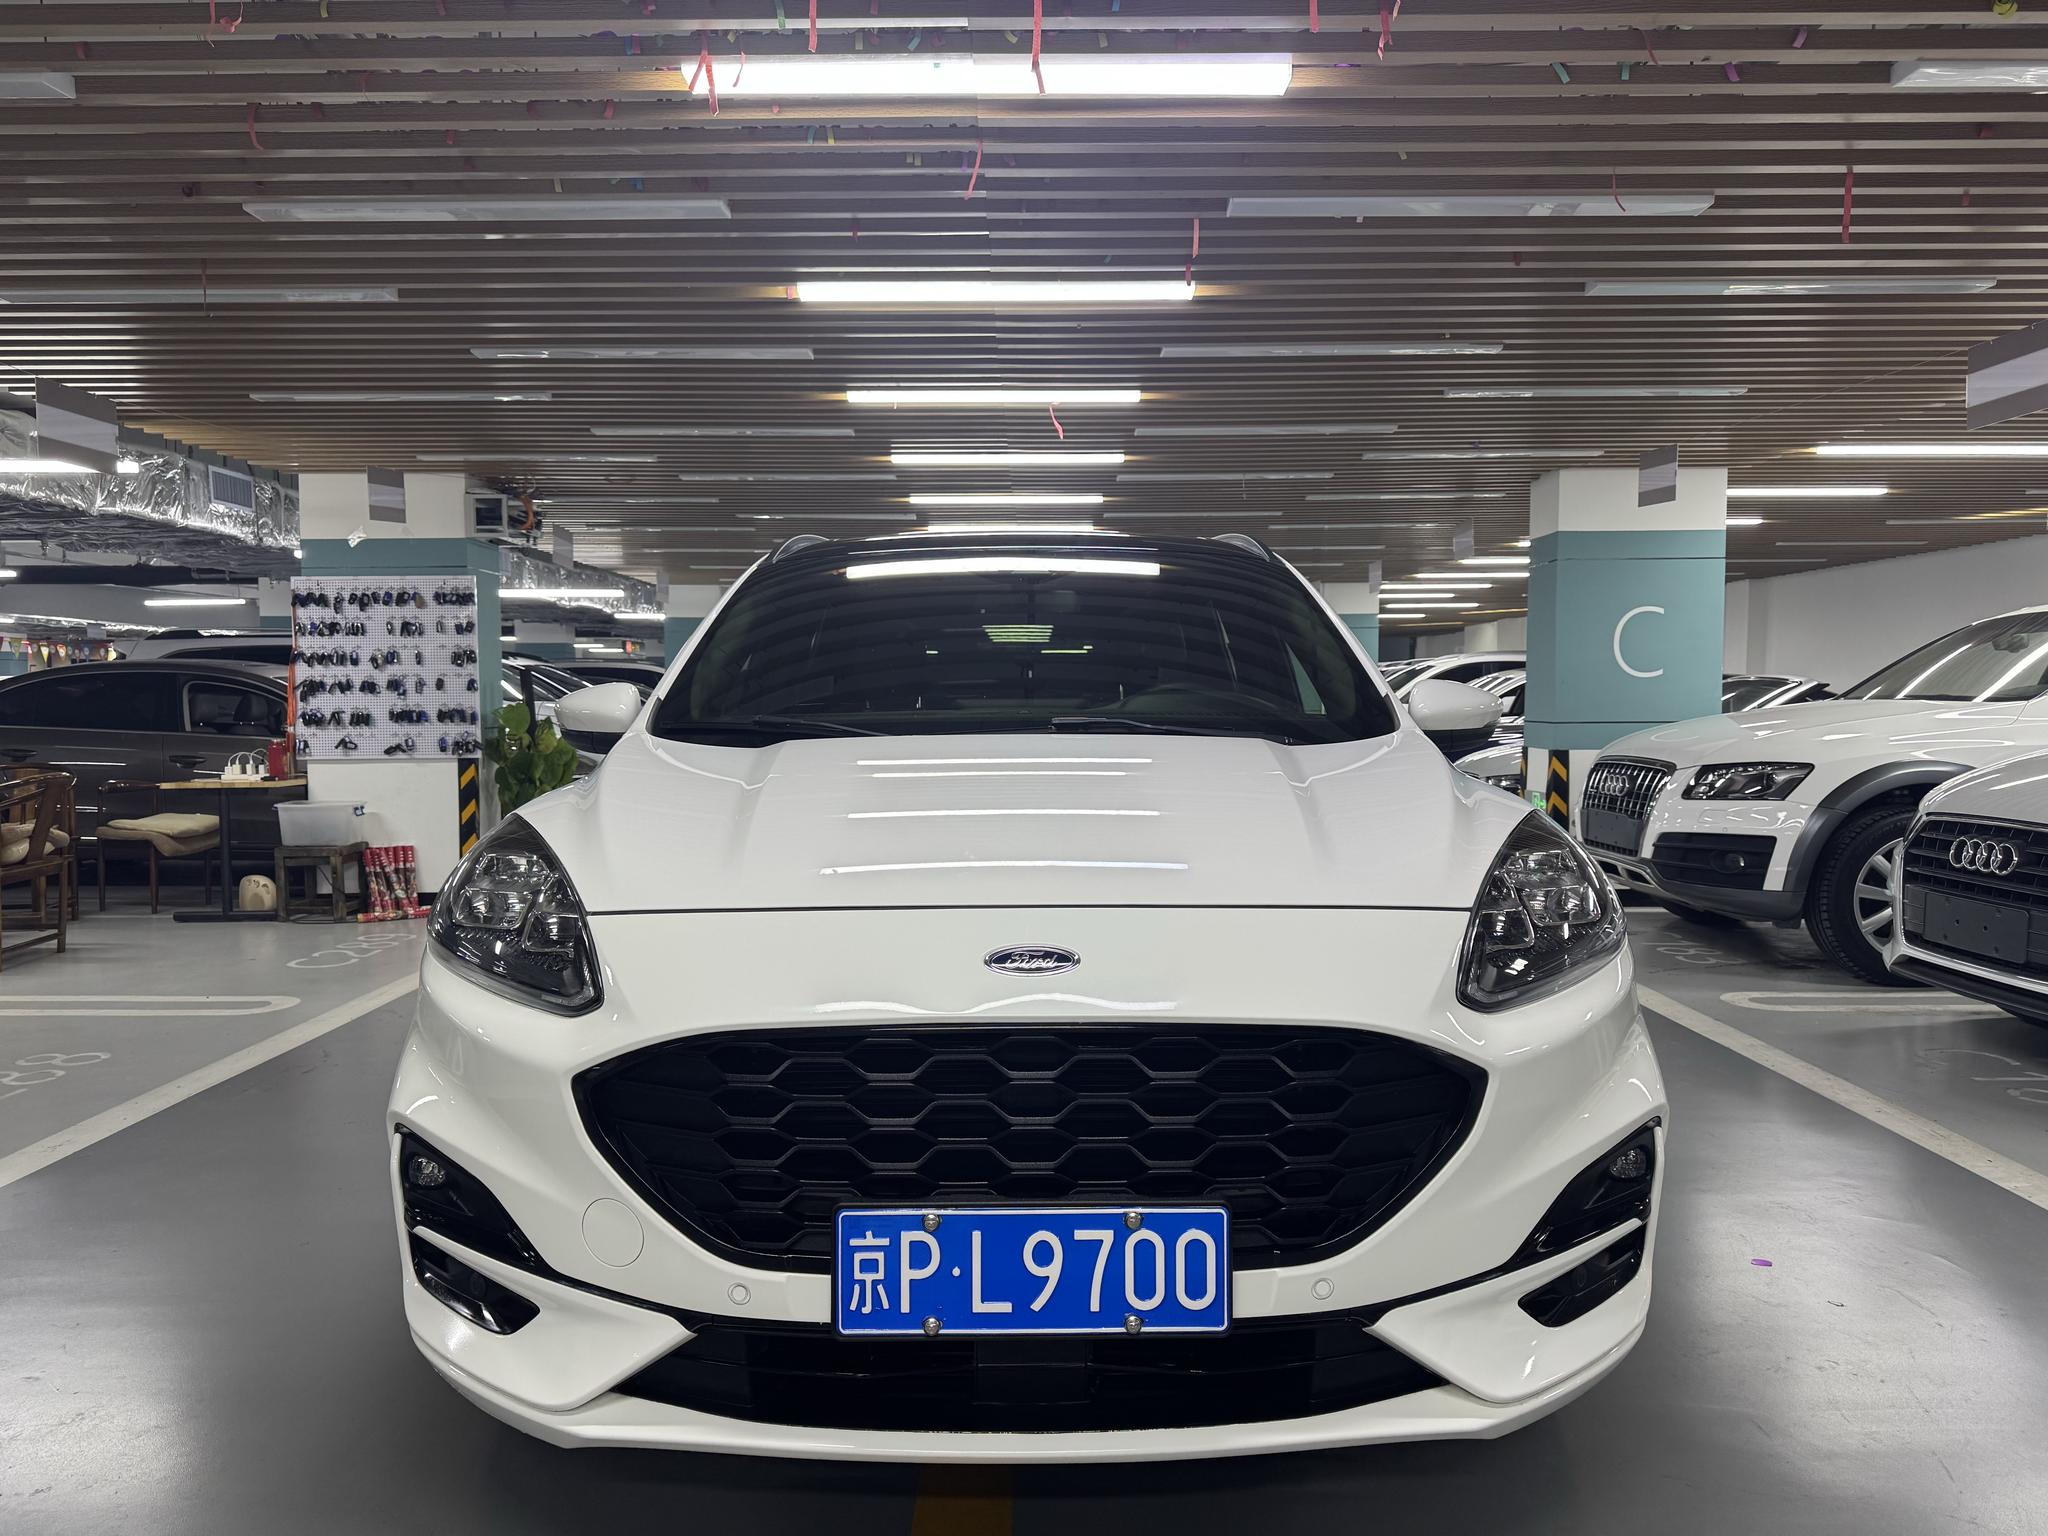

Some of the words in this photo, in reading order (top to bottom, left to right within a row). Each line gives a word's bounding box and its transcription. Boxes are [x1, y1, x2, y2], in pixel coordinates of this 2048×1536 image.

[1613, 605, 1665, 678] C
[286, 933, 417, 969] C289
[1005, 950, 1058, 969] Ford
